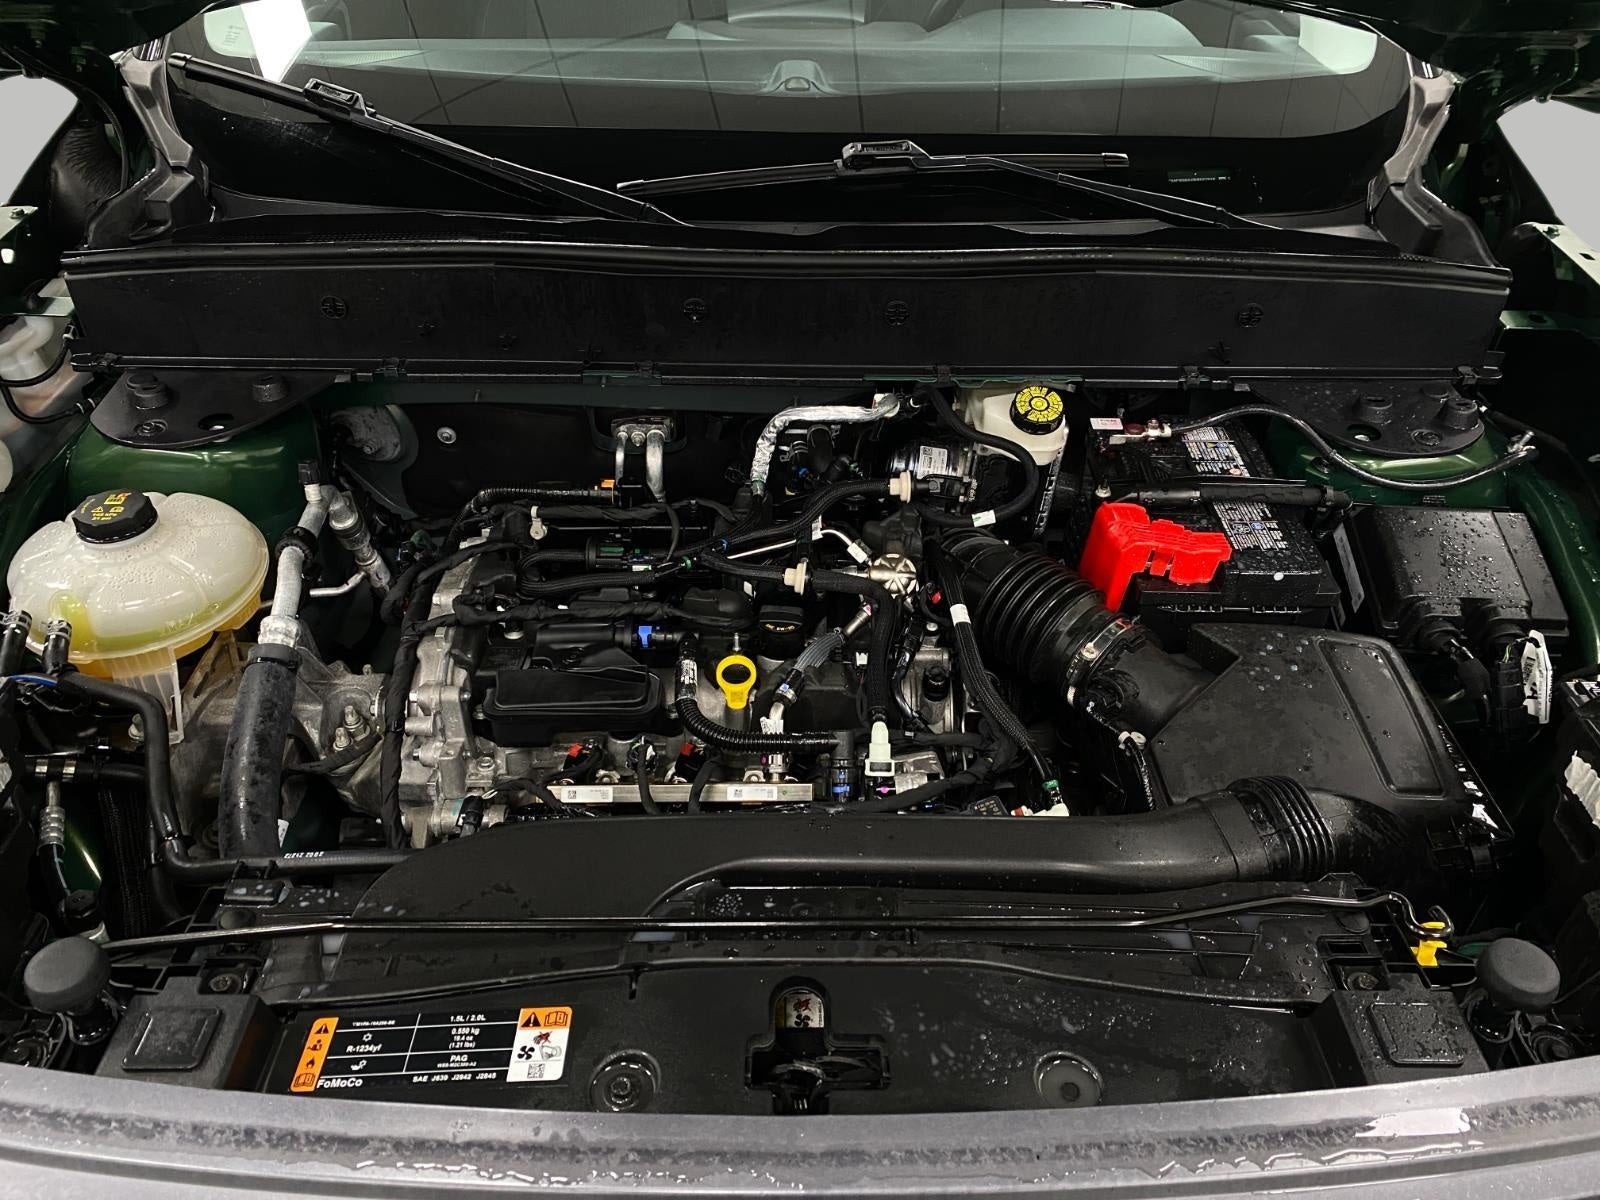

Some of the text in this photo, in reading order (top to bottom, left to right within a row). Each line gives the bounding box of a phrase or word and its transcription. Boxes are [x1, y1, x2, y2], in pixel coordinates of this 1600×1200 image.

[470, 1027, 480, 1035] kg
[346, 1044, 382, 1053] R-1234yf
[450, 1054, 468, 1062] PAG
[412, 1075, 429, 1083] SAE
[316, 1078, 363, 1089] FoMoCo
